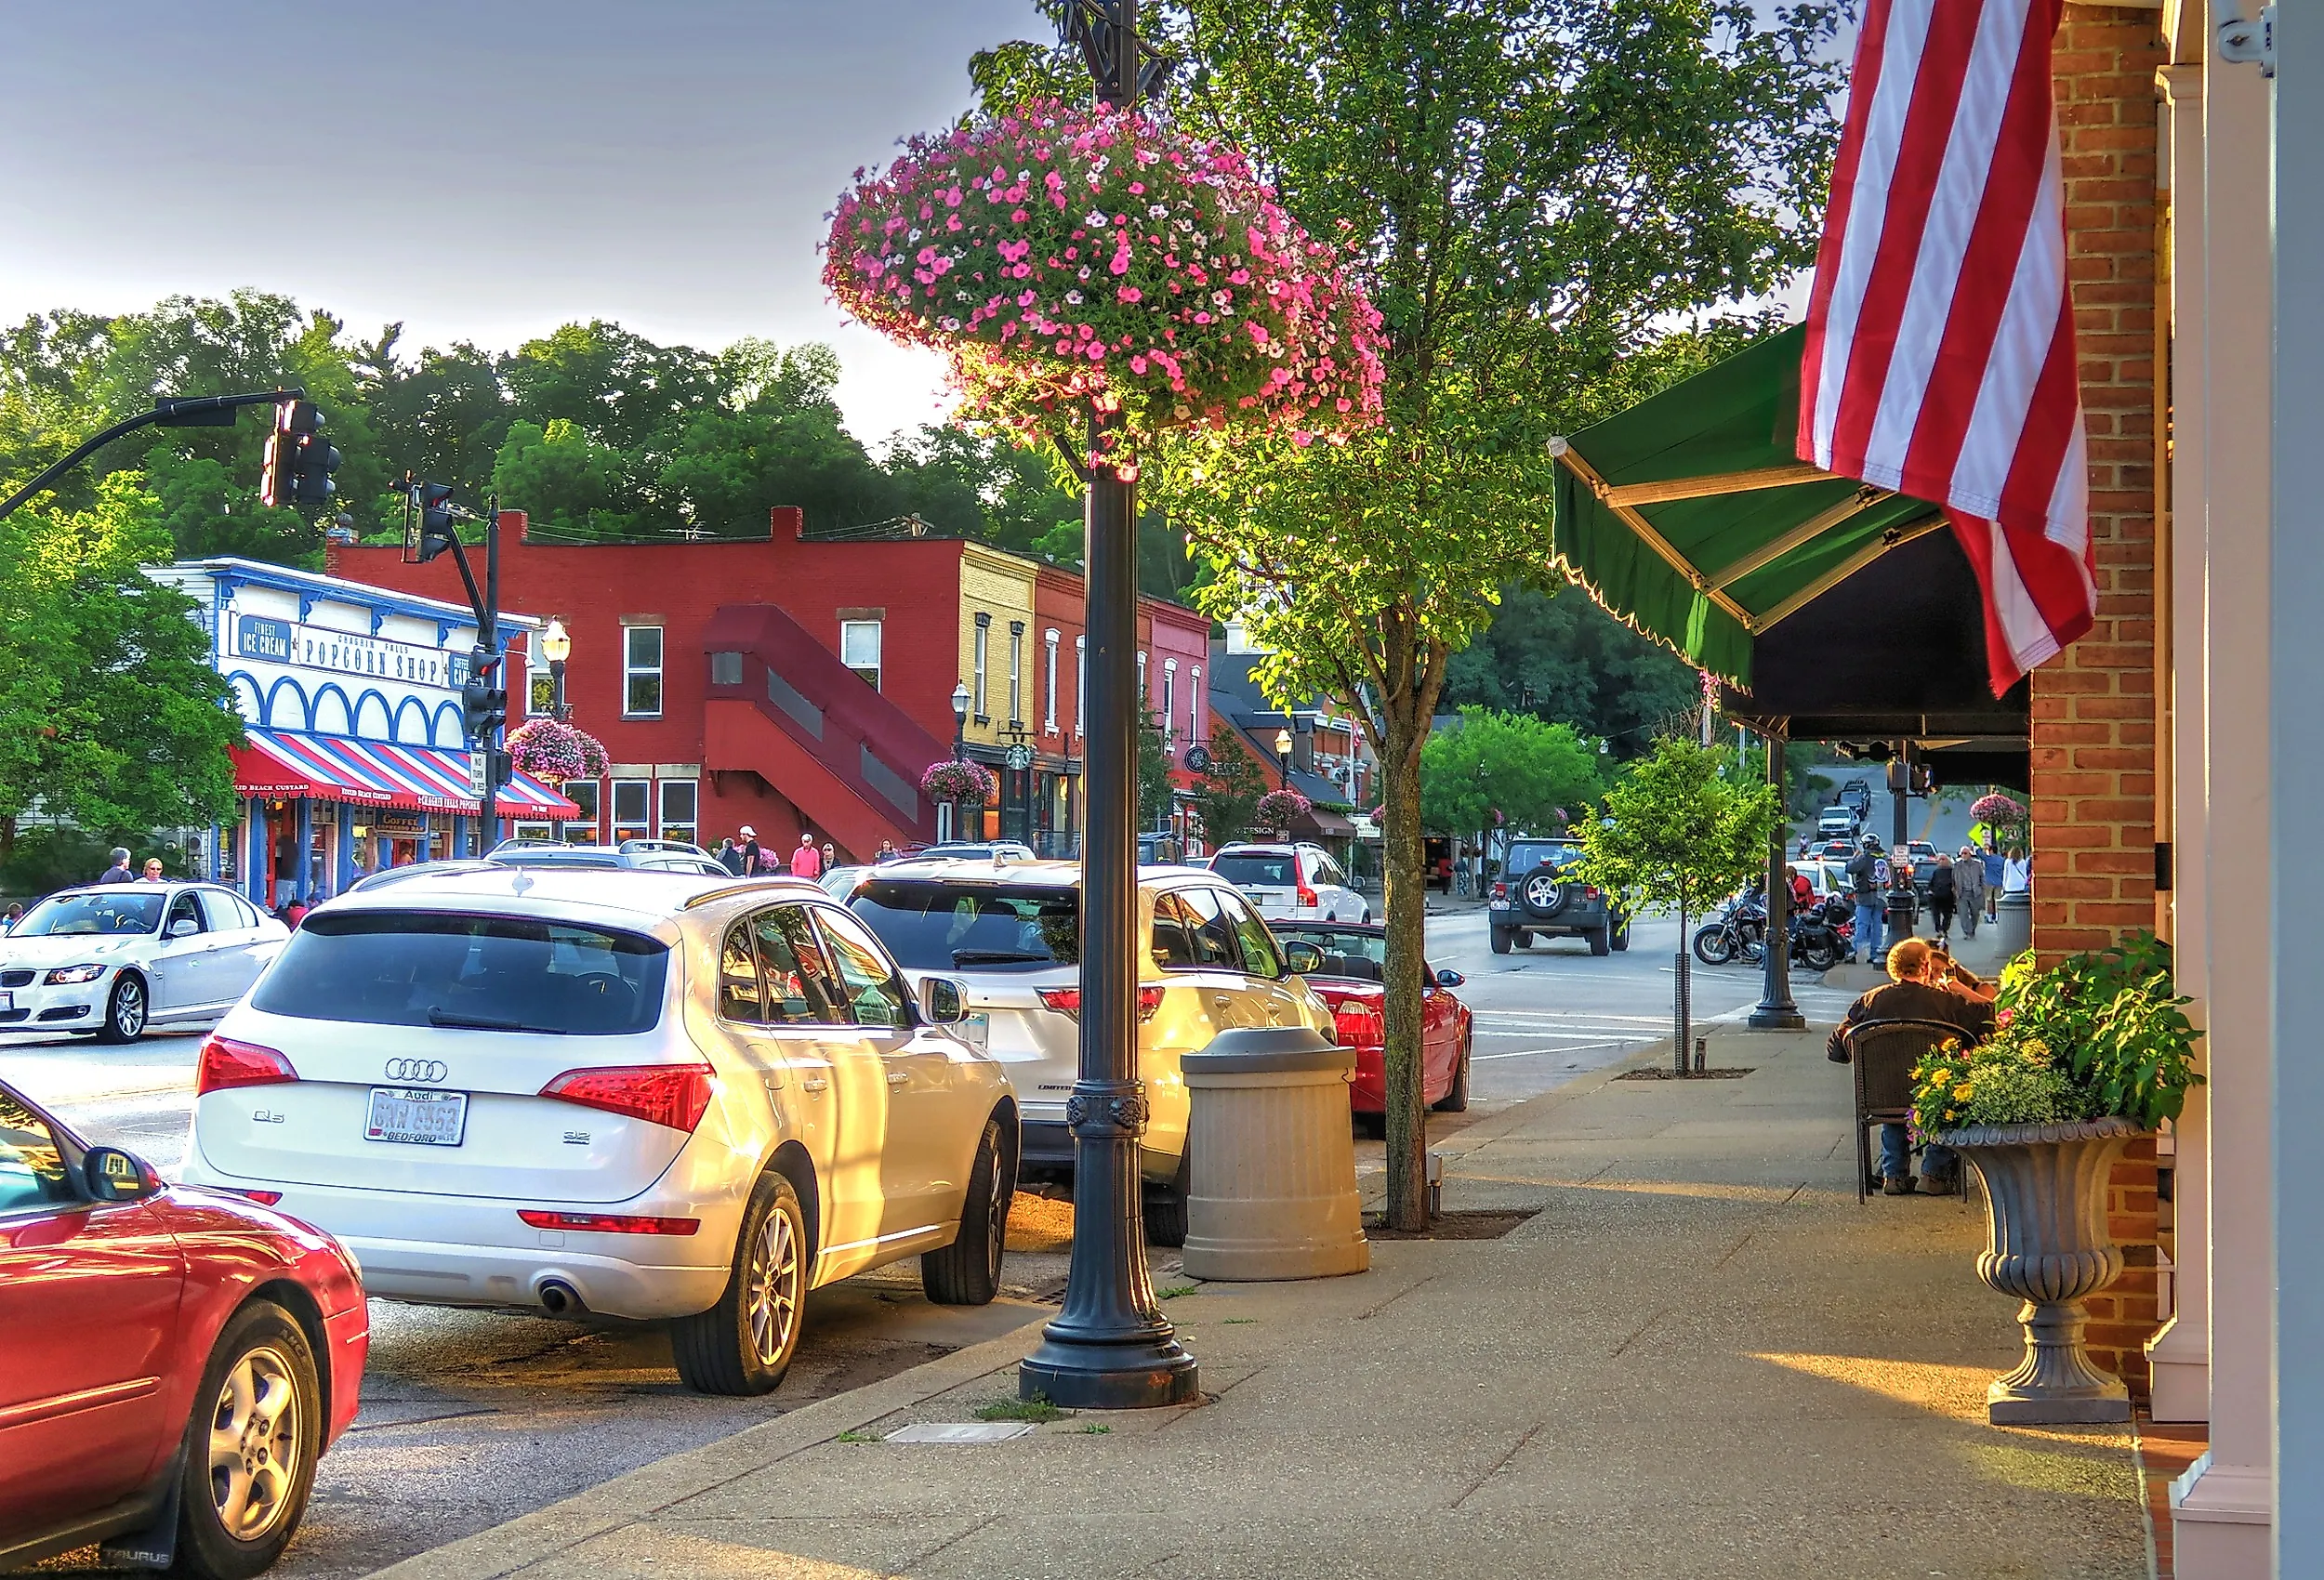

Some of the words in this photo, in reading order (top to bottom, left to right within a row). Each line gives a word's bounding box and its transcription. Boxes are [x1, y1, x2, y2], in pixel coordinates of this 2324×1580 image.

[254, 621, 276, 636] FINEST
[243, 633, 257, 652] ICE
[259, 635, 286, 657] CREAM
[337, 635, 375, 649] CHAGRIN
[385, 643, 409, 654] FALLS
[306, 639, 386, 675] POPCORN
[396, 654, 437, 681] SHOP
[1244, 826, 1274, 835] DESIGN
[403, 1090, 433, 1100] Audi
[252, 1110, 284, 1124] Q5
[387, 1131, 437, 1143] BEDFORD
[102, 1548, 169, 1563] TAURUS
